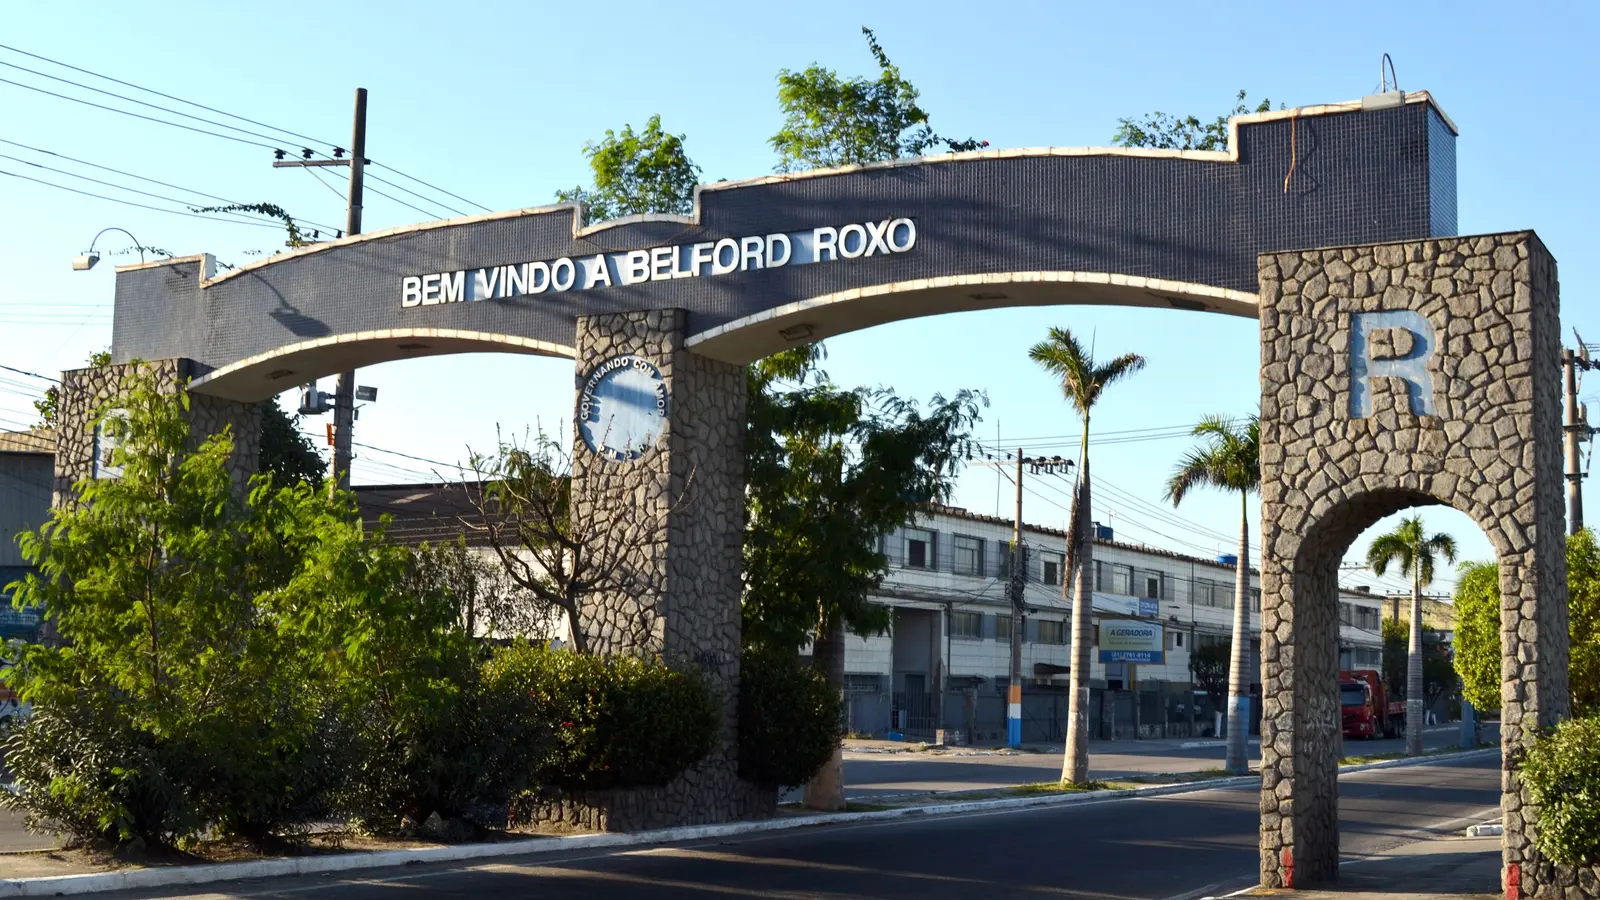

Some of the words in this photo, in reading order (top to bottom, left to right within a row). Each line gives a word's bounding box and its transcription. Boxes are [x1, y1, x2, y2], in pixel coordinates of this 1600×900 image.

[401, 271, 465, 308] BEM
[480, 257, 576, 300] VINDO
[587, 254, 611, 289] A
[627, 233, 792, 285] BELFORD
[813, 217, 917, 263] ROXO
[580, 356, 629, 420] GOVERNANDO
[633, 360, 655, 378] COM
[1351, 310, 1435, 419] R
[1116, 629, 1153, 637] GERADORA
